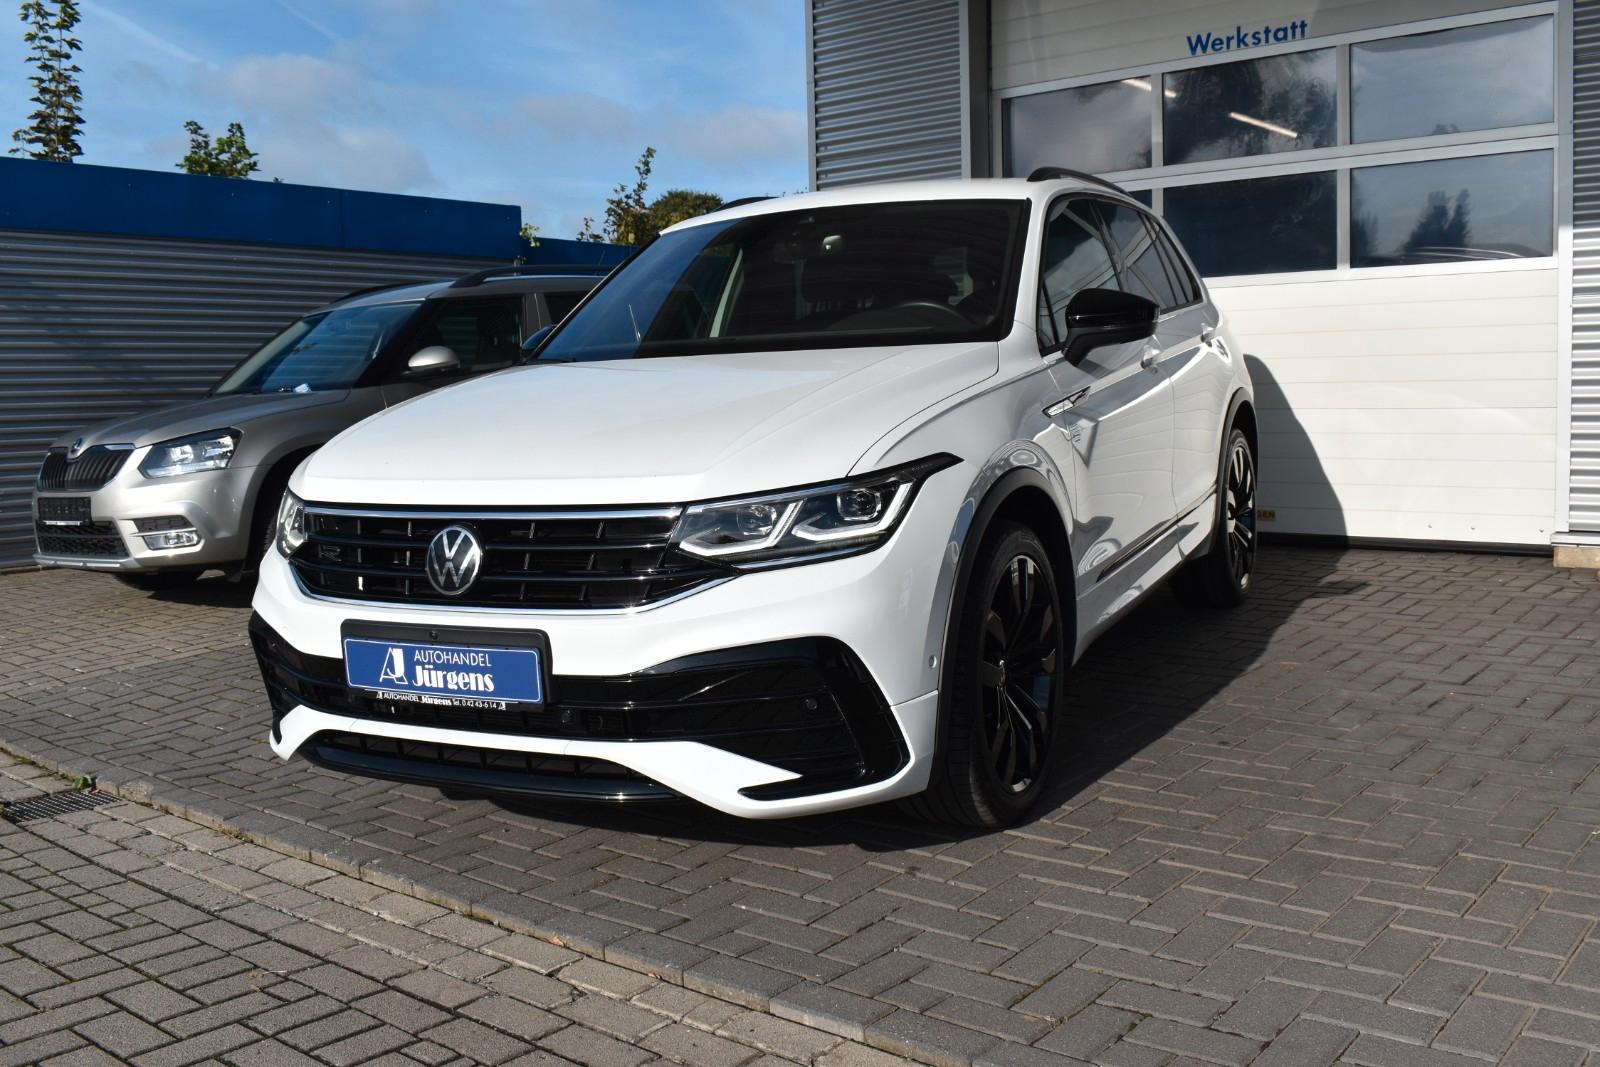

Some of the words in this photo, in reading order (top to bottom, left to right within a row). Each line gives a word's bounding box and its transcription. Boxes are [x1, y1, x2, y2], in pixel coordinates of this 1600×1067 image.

[1187, 20, 1307, 56] Werkstatt
[414, 650, 492, 666] AUTOHANDEL
[412, 665, 495, 692] Jürgens
[383, 692, 419, 702] AUTOHANDEL
